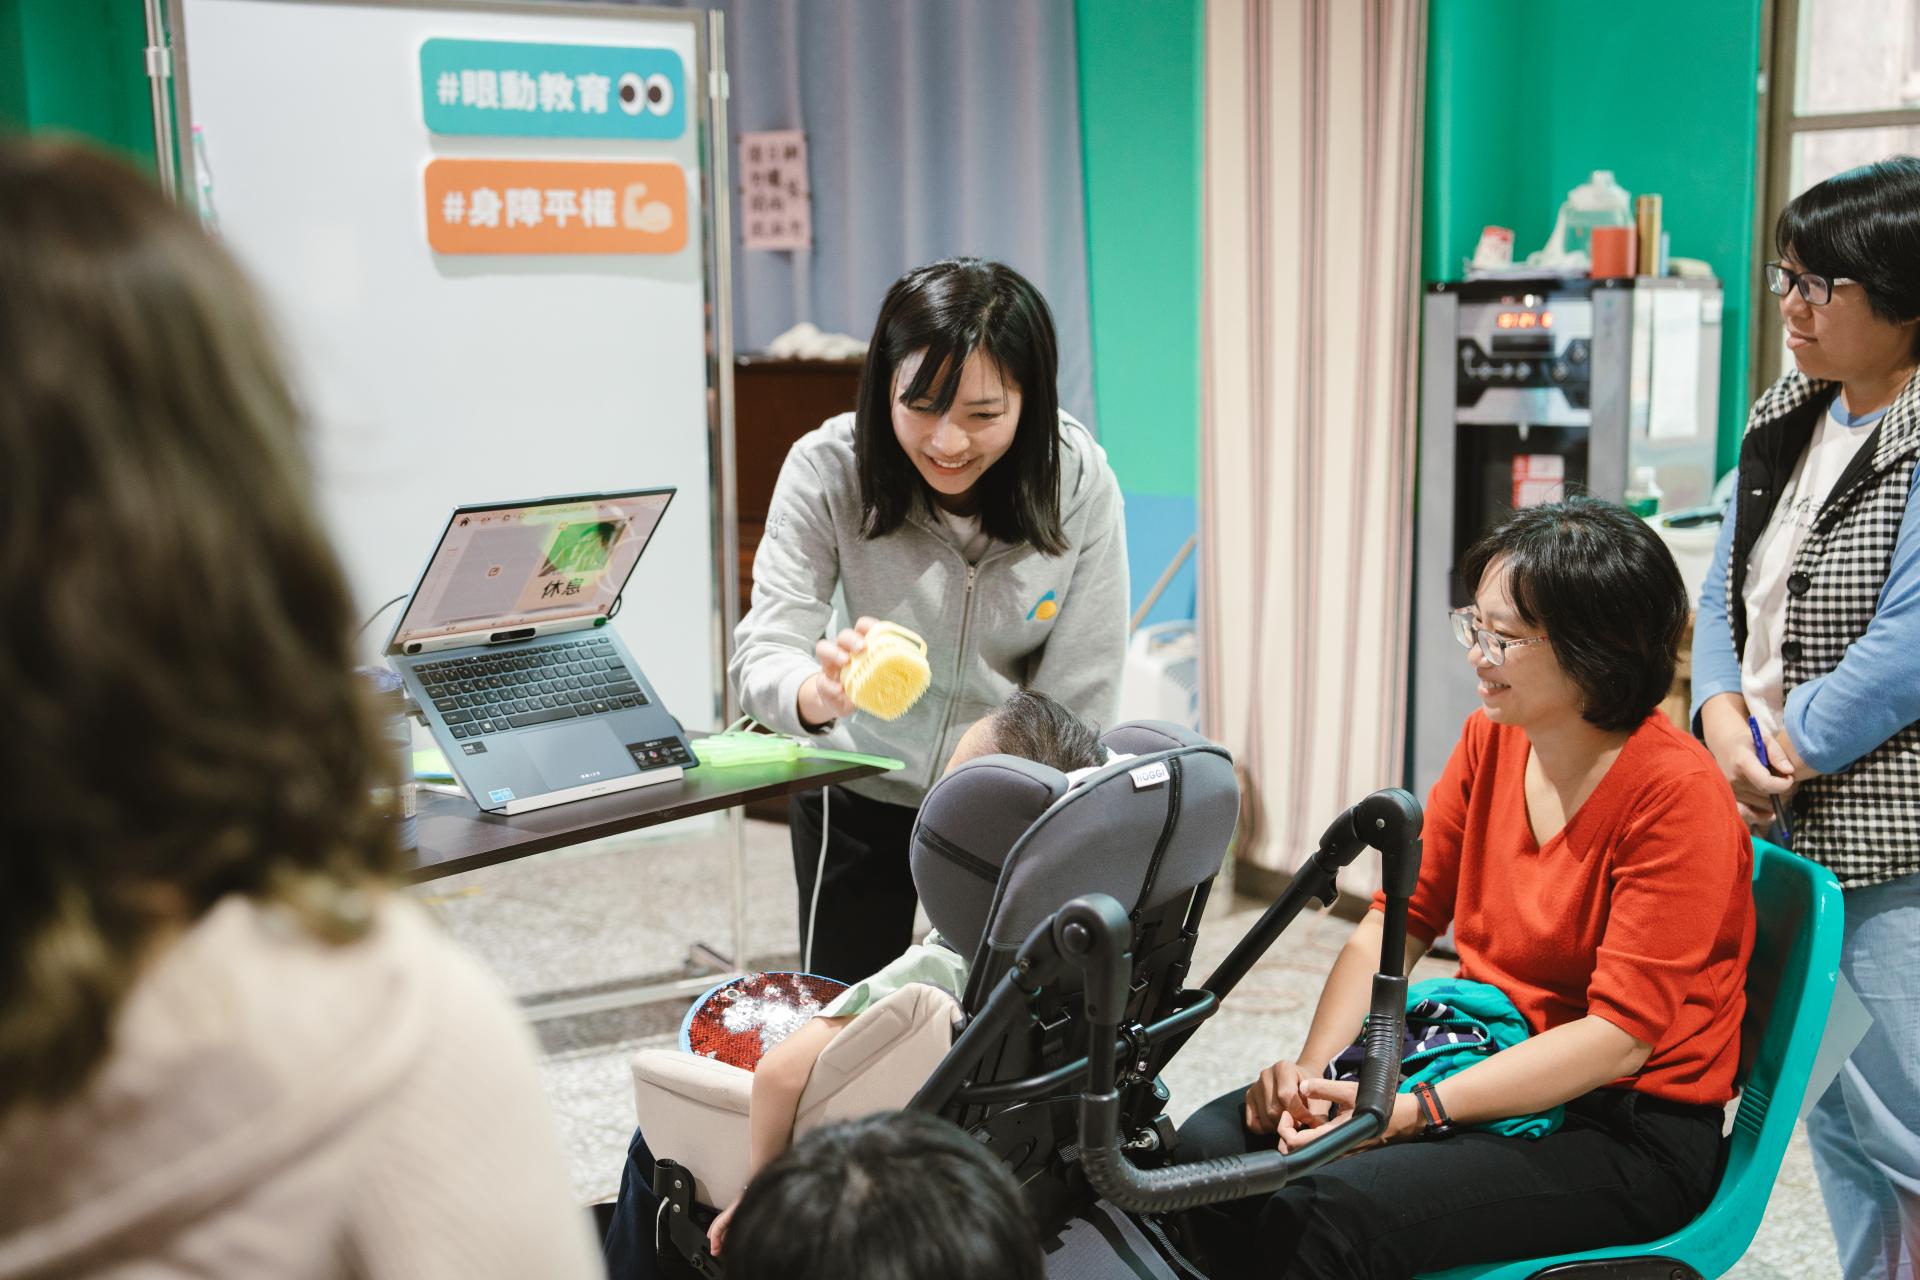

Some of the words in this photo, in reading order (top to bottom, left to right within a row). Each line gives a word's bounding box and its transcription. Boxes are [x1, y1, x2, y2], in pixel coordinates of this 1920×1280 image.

[437, 69, 611, 114] #眼動教育
[443, 186, 617, 228] #身障平權
[541, 578, 584, 599] 休息
